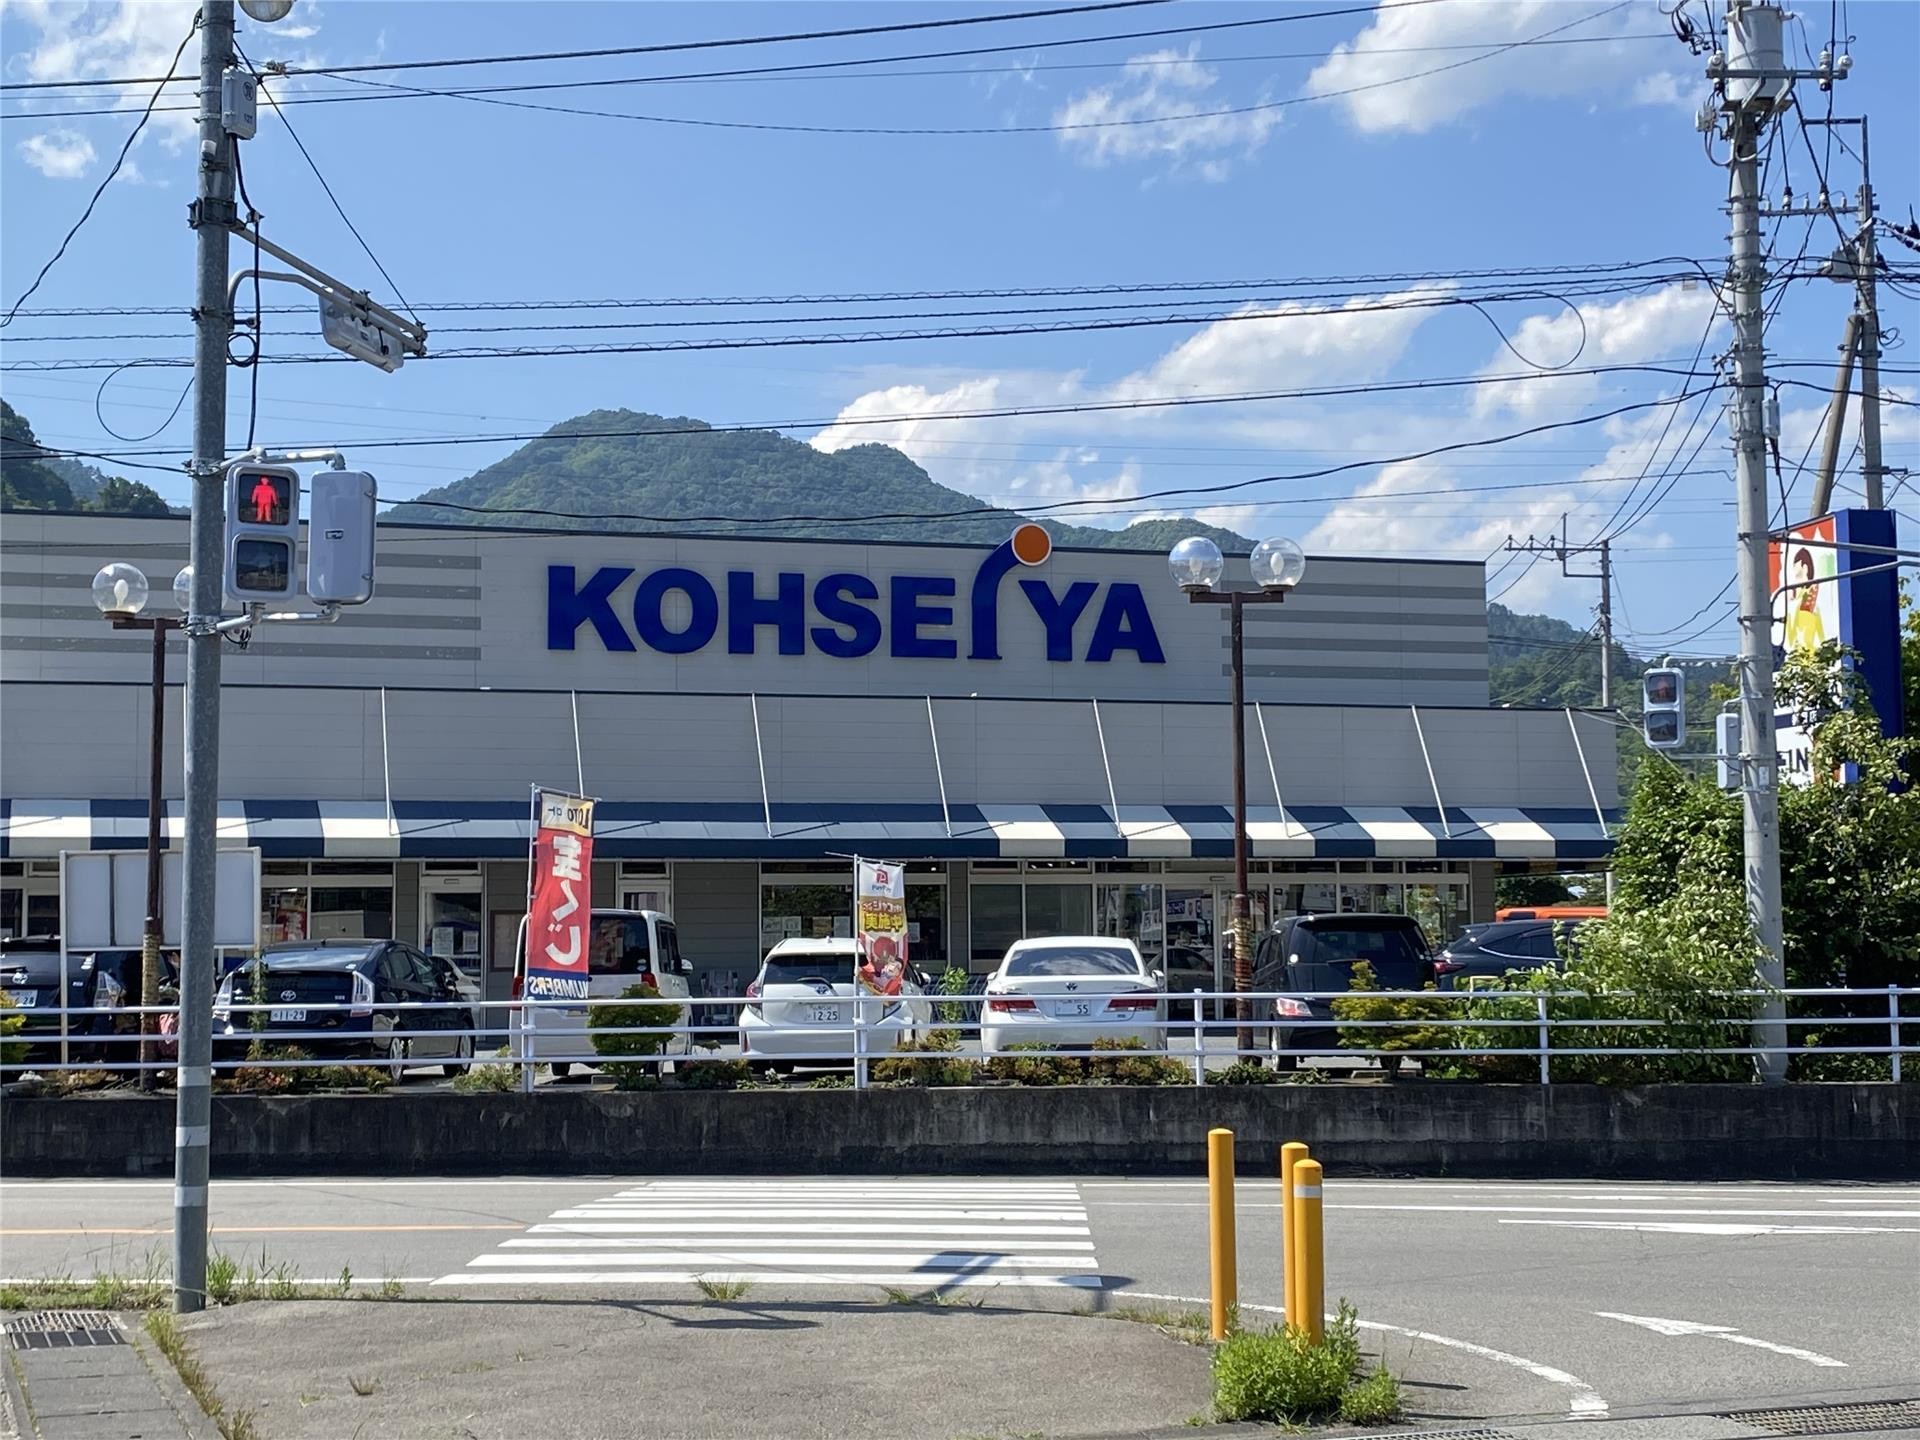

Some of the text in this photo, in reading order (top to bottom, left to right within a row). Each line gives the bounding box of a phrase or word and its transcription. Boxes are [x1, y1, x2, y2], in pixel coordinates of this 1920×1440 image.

[547, 523, 1166, 664] KOHSEIYA
[865, 912, 903, 931] 実施中
